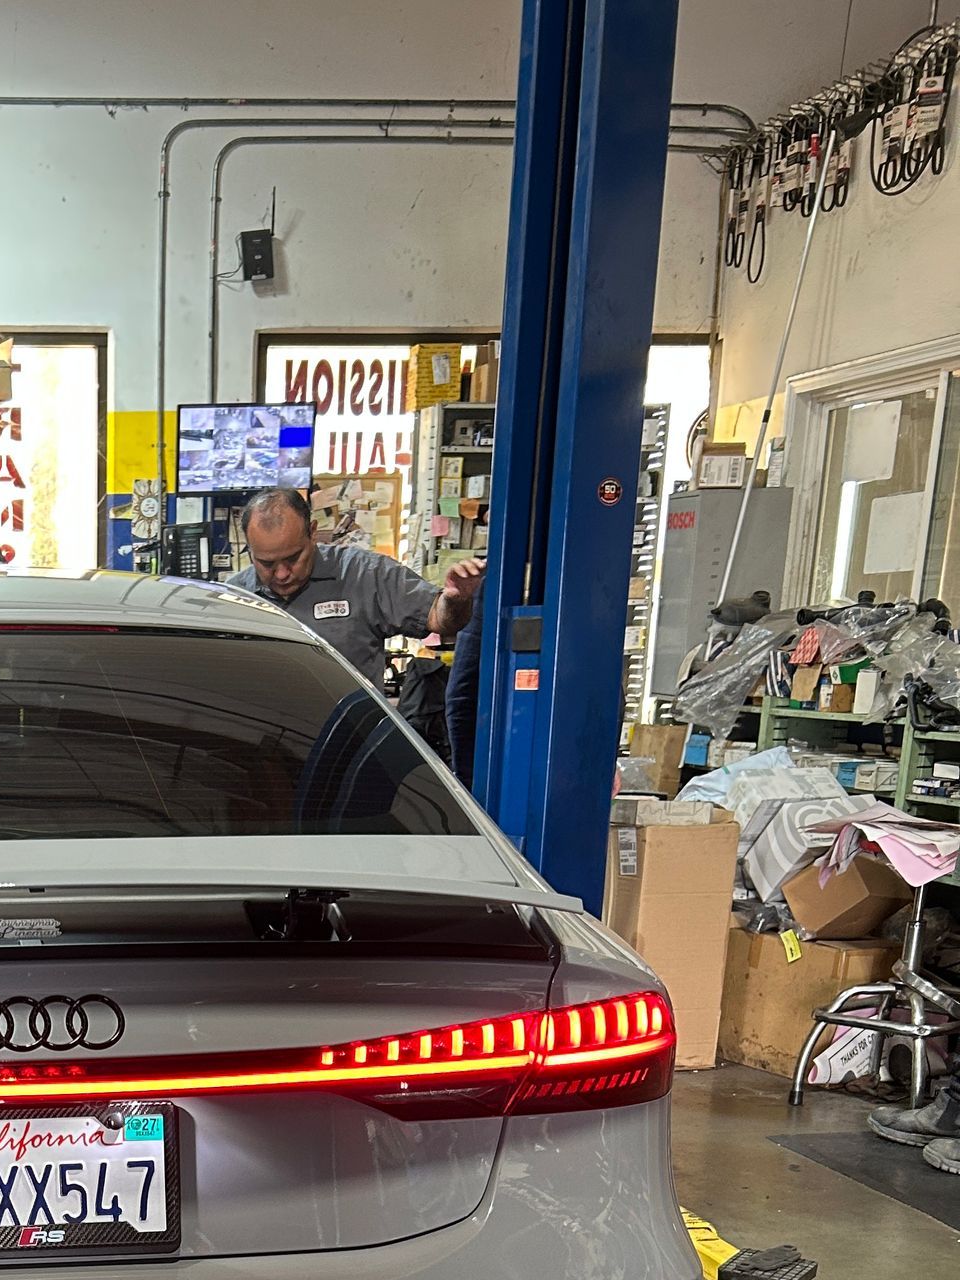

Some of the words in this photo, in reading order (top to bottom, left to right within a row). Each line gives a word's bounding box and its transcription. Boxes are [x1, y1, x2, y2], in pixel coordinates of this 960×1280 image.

[668, 511, 696, 530] BOSCH
[840, 1046, 859, 1066] THANKS
[142, 1118, 157, 1130] 27
